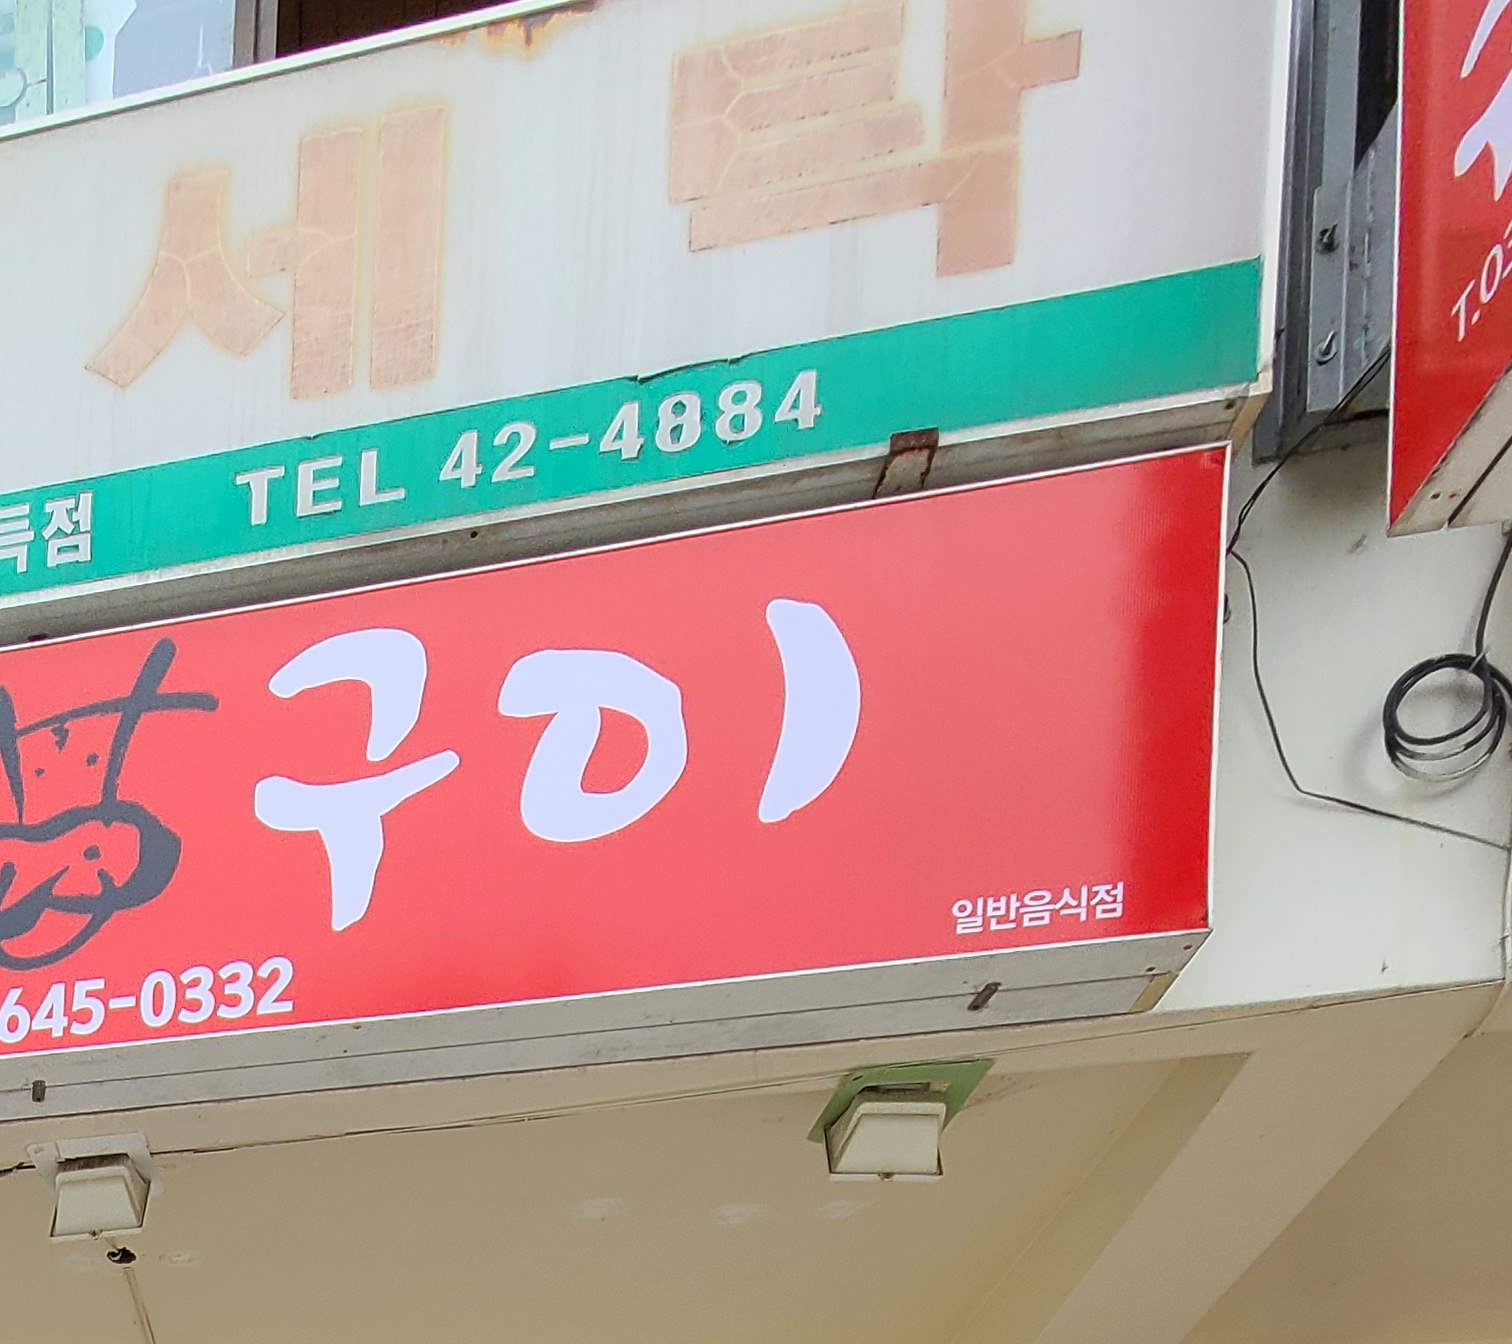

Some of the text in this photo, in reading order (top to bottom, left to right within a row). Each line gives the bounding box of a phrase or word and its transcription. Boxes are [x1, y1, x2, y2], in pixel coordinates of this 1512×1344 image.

[235, 368, 824, 528] TEL 42-4884
[254, 597, 862, 932] 구이
[950, 882, 1126, 937] 일반음식점
